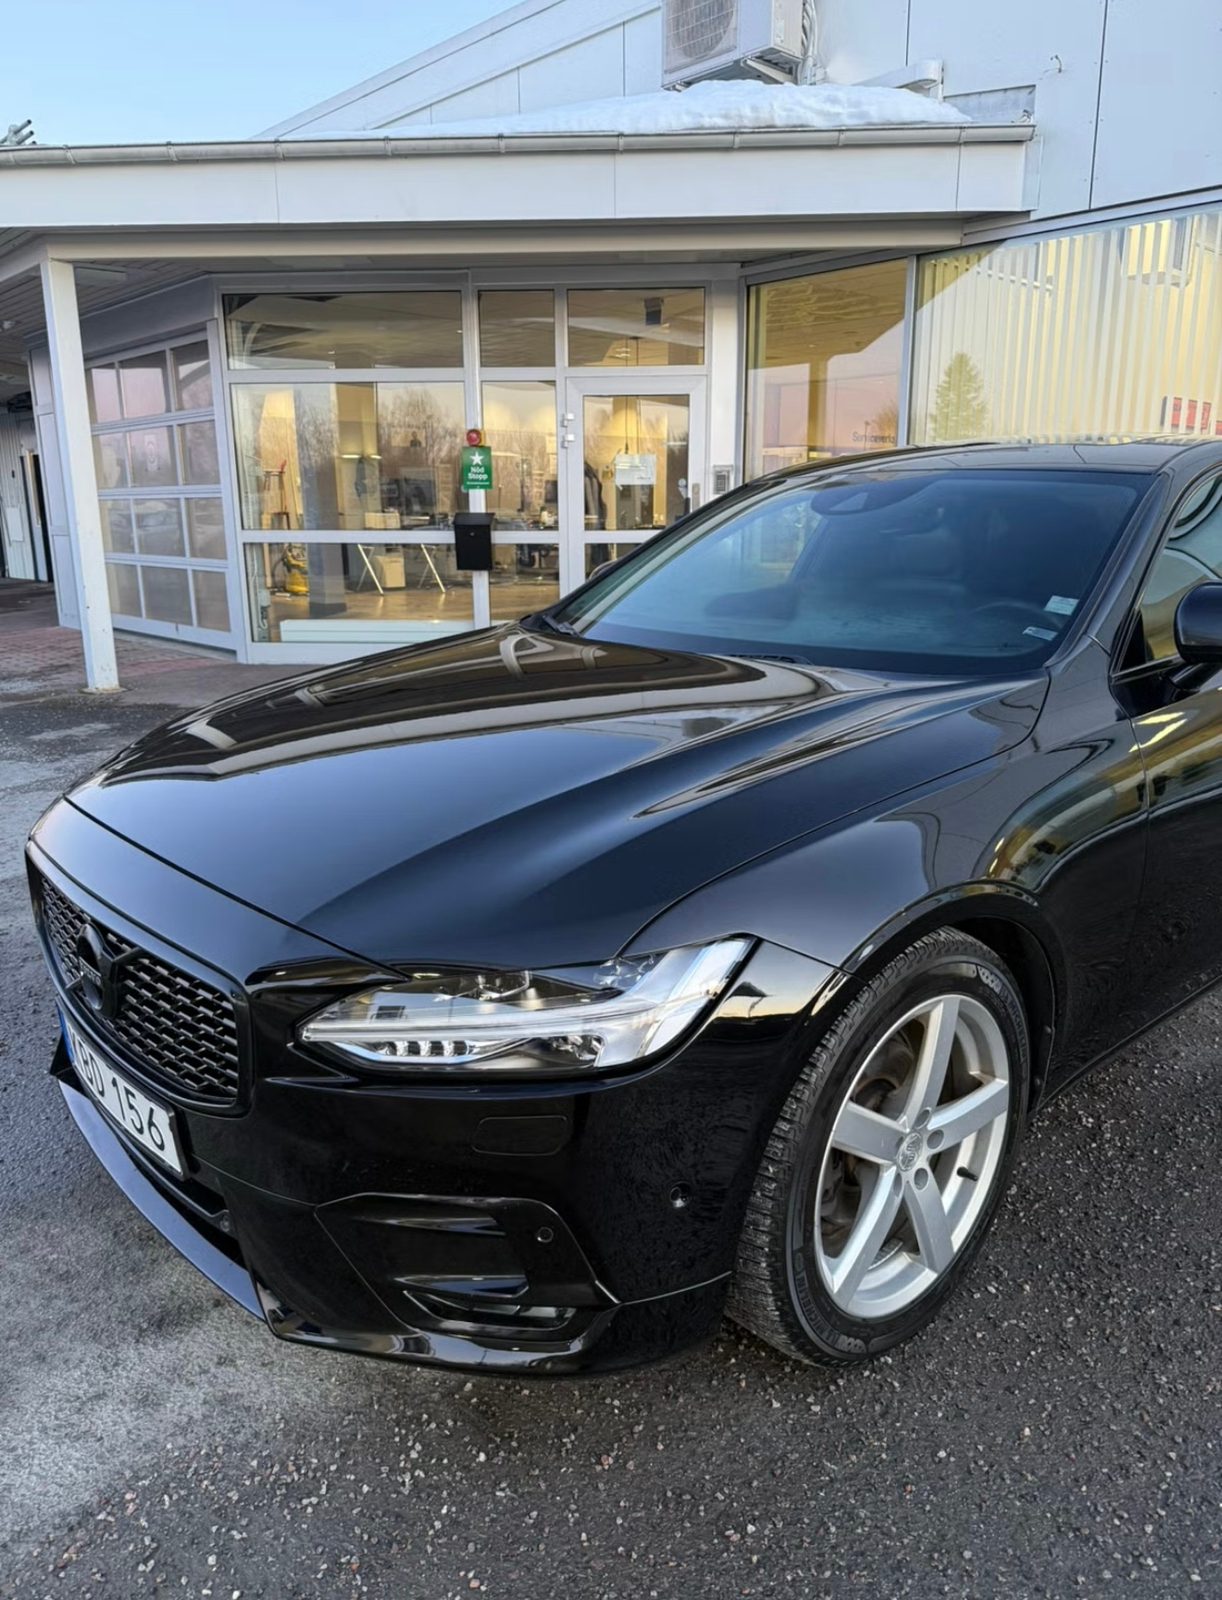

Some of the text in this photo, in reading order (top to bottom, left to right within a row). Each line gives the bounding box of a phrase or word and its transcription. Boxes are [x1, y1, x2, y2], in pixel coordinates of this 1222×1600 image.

[467, 472, 489, 481] Stopp
[111, 1076, 165, 1152] 156
[796, 1275, 829, 1337] MICHELIN
